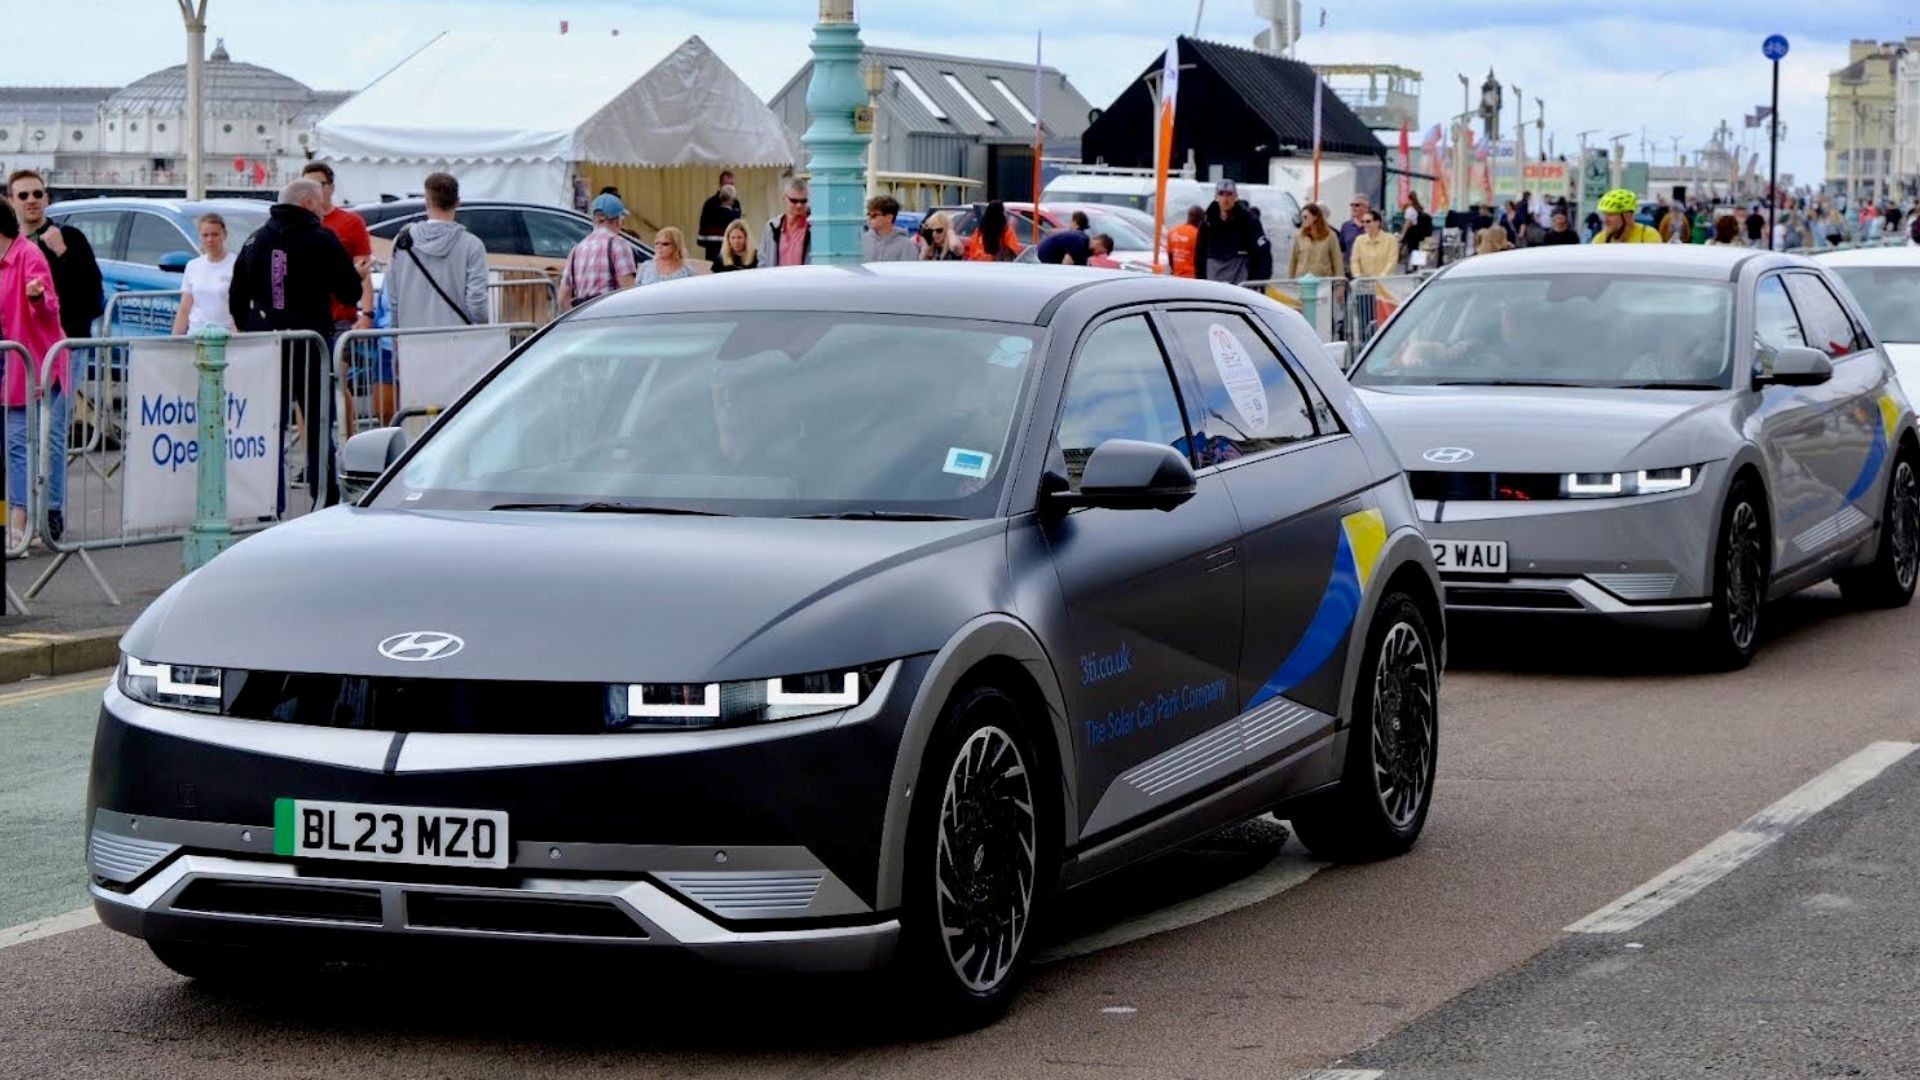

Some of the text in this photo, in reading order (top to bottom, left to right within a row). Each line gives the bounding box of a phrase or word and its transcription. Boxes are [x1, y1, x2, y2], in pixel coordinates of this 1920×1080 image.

[142, 392, 247, 428] Motaty
[153, 429, 265, 472] Opeions
[1454, 544, 1501, 568] WAU
[1080, 640, 1132, 686] 3ti.co.uk
[1085, 679, 1227, 748] The Solar Car Park Company
[302, 808, 497, 860] BL23 MZO
